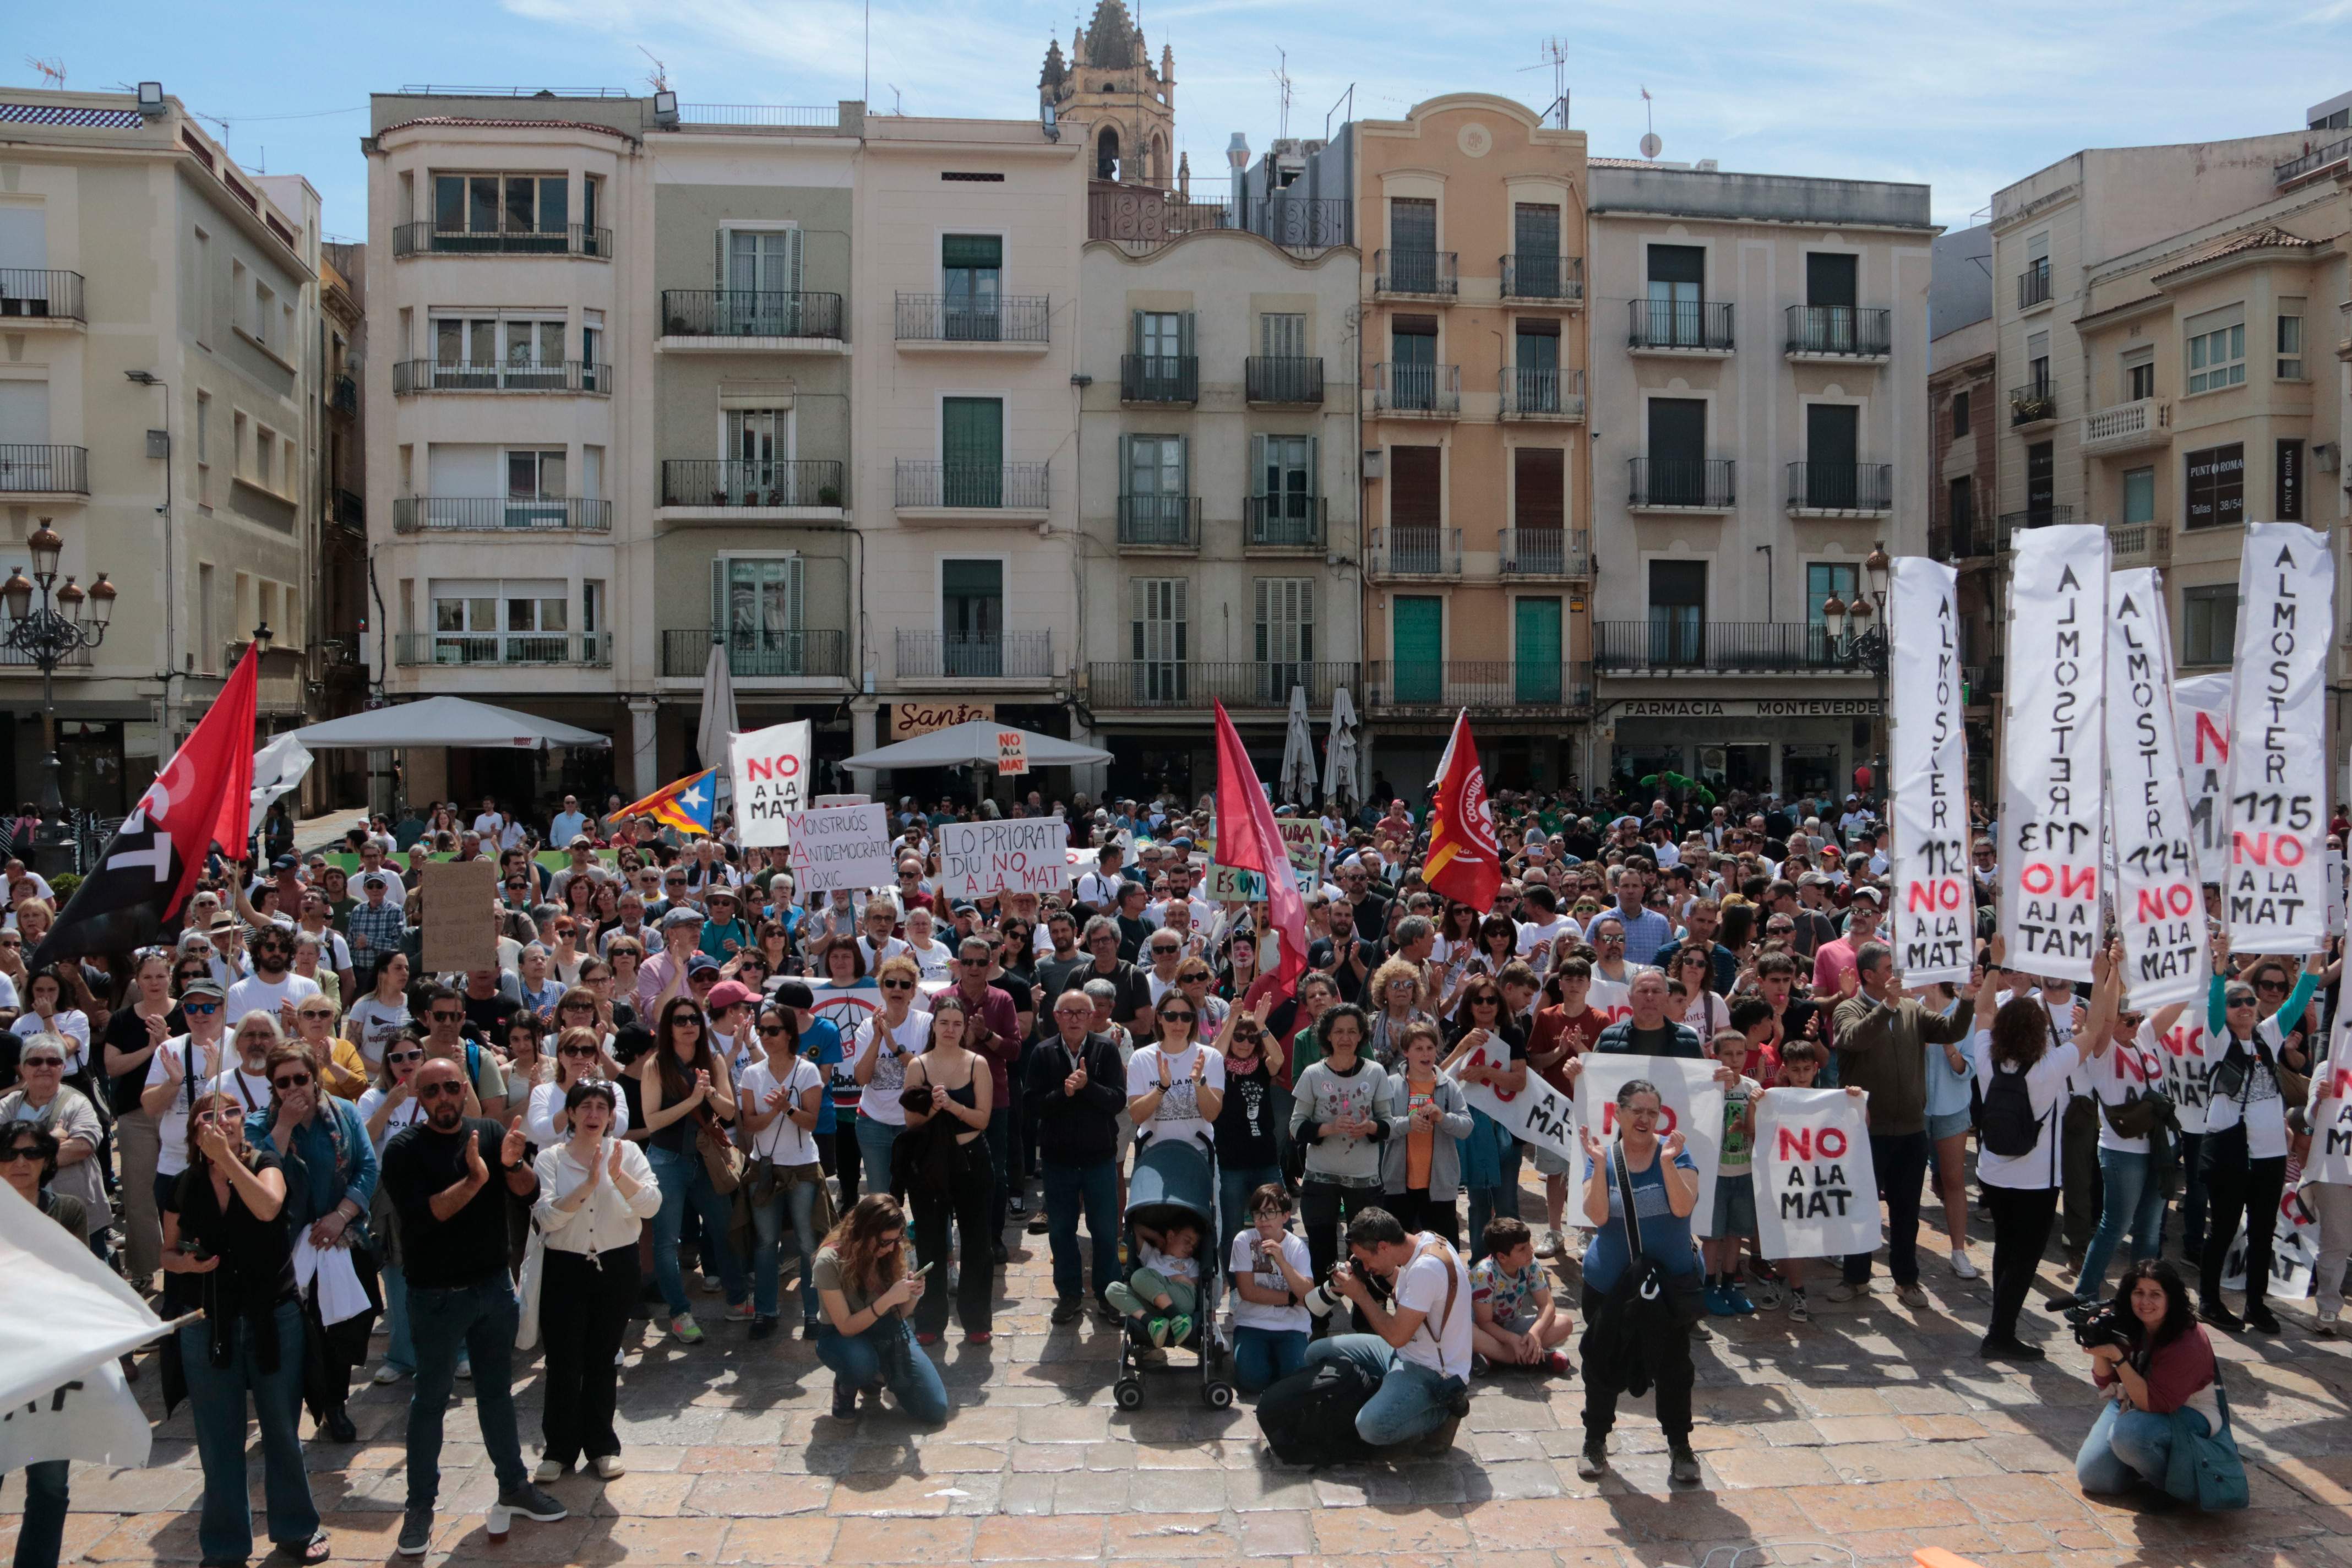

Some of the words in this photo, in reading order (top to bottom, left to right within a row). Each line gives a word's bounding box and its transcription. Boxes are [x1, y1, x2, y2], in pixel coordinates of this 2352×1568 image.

[2190, 466, 2211, 477] PUNT
[2220, 459, 2243, 473] ROMA
[2284, 450, 2293, 477] ROMA
[2191, 503, 2211, 514] Tallas
[2220, 498, 2242, 511] 38/54
[2284, 484, 2292, 512] PUNT
[2265, 544, 2297, 783] ALMOSTER
[899, 703, 989, 731] Santa
[1626, 703, 1723, 715] FARMACIA
[1757, 702, 1878, 714] MONTEVERDE
[2117, 594, 2163, 839] ALMOSTER
[999, 734, 1020, 746] NO
[1001, 747, 1010, 756] A
[2195, 711, 2228, 765] N
[747, 754, 799, 781] NO
[999, 760, 1024, 771] MAT
[755, 785, 766, 798] A
[775, 781, 796, 796] LA
[2202, 769, 2219, 793] A
[750, 798, 799, 819] MAT
[2233, 792, 2312, 830] 115
[786, 810, 868, 837] MONSTRUÓS
[793, 836, 891, 863] ANTIDEMOCRÀTIC
[944, 828, 975, 855] LO
[2232, 831, 2305, 868] NO
[993, 852, 1026, 872] NO
[1918, 840, 1963, 875] 112
[2127, 840, 2190, 878] 114
[793, 866, 842, 890] TÒXIC
[966, 874, 978, 894] A
[987, 872, 1005, 892] LA
[1022, 866, 1061, 890] MAT
[2239, 873, 2255, 891] A
[2268, 872, 2297, 894] LA
[1908, 879, 1960, 912] NO
[2137, 884, 2193, 923] NO
[2231, 897, 2304, 925] MAT
[1915, 918, 1925, 937] A
[1935, 916, 1958, 937] LA
[2147, 927, 2159, 948] A
[2169, 922, 2191, 945] LA
[1907, 941, 1962, 968] MAT
[2140, 946, 2197, 981] MAT
[2115, 1046, 2163, 1083] NO
[2169, 1058, 2179, 1077] A
[2126, 1086, 2138, 1101] A
[1542, 1093, 1555, 1112] A
[1562, 1107, 1573, 1124] L
[1526, 1104, 1573, 1145] MA
[1779, 1128, 1847, 1161] NO
[1788, 1166, 1805, 1186] A
[1815, 1164, 1846, 1185] LA
[1781, 1189, 1852, 1219] MAT
